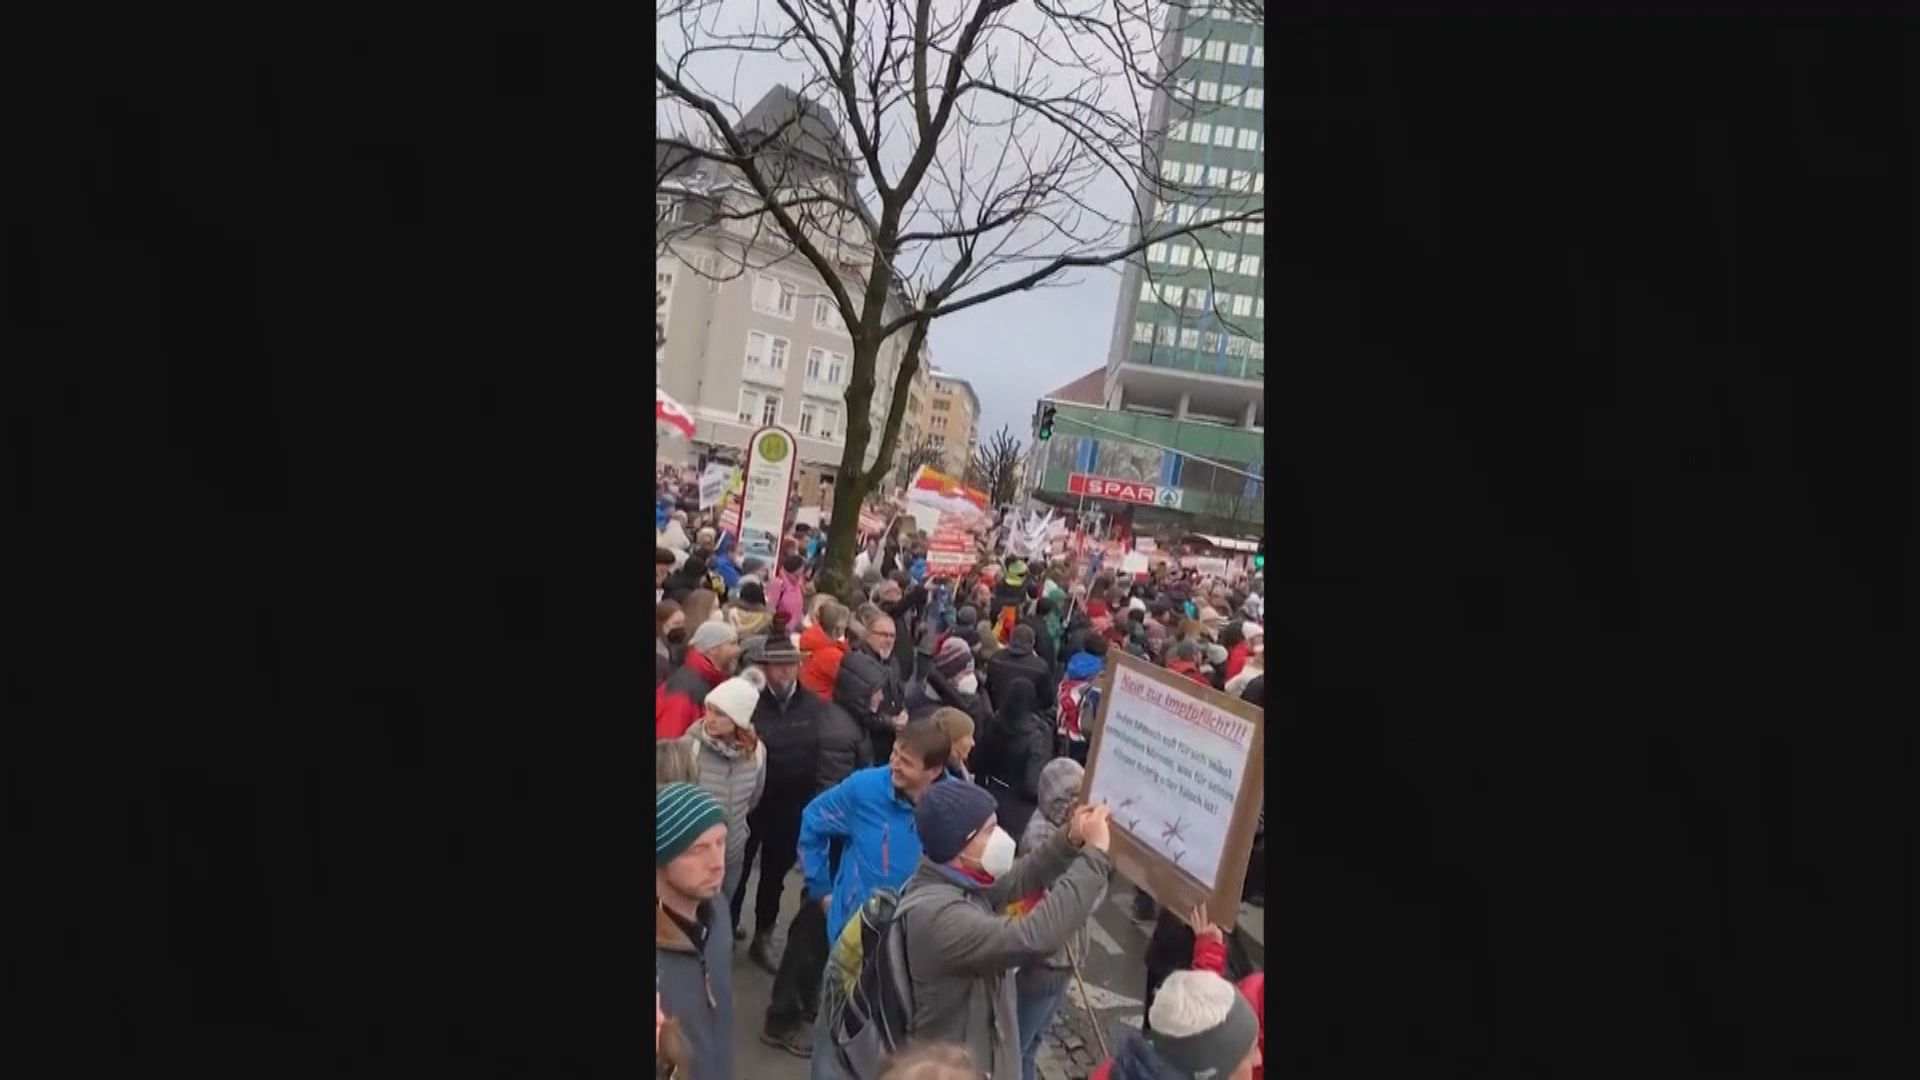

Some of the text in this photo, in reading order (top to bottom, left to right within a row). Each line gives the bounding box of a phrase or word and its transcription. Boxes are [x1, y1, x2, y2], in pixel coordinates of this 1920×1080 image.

[1088, 480, 1154, 502] SPAR
[1121, 674, 1144, 694] Nein
[1145, 686, 1162, 703] zur
